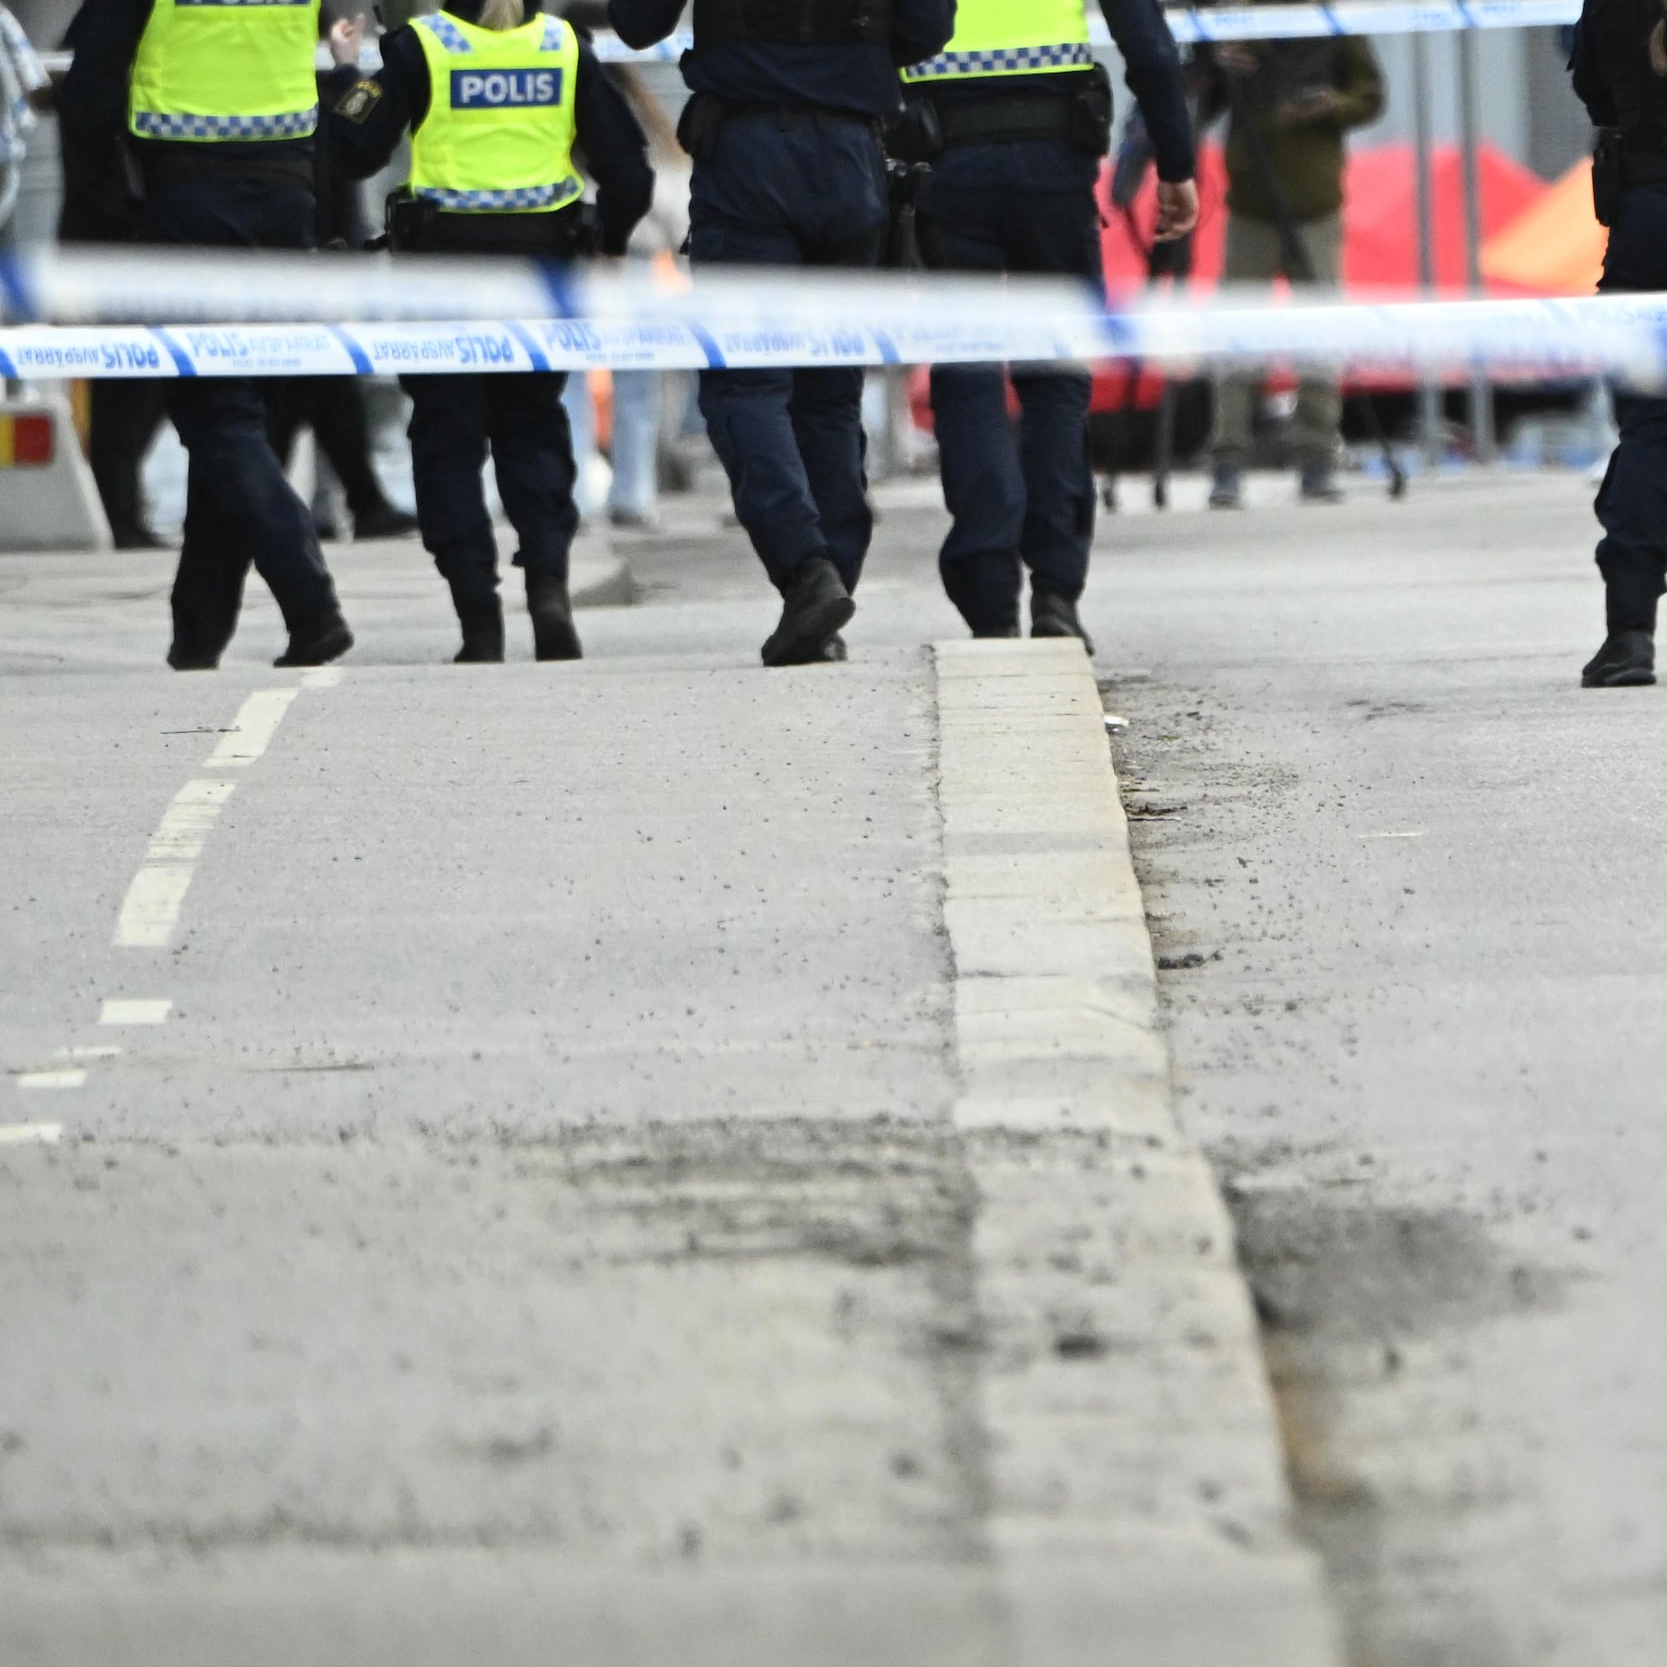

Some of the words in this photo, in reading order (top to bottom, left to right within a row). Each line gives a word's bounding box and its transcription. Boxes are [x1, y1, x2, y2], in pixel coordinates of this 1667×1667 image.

[461, 73, 554, 104] POLIS
[103, 344, 160, 370] POLIS
[459, 334, 515, 366] POLIS
